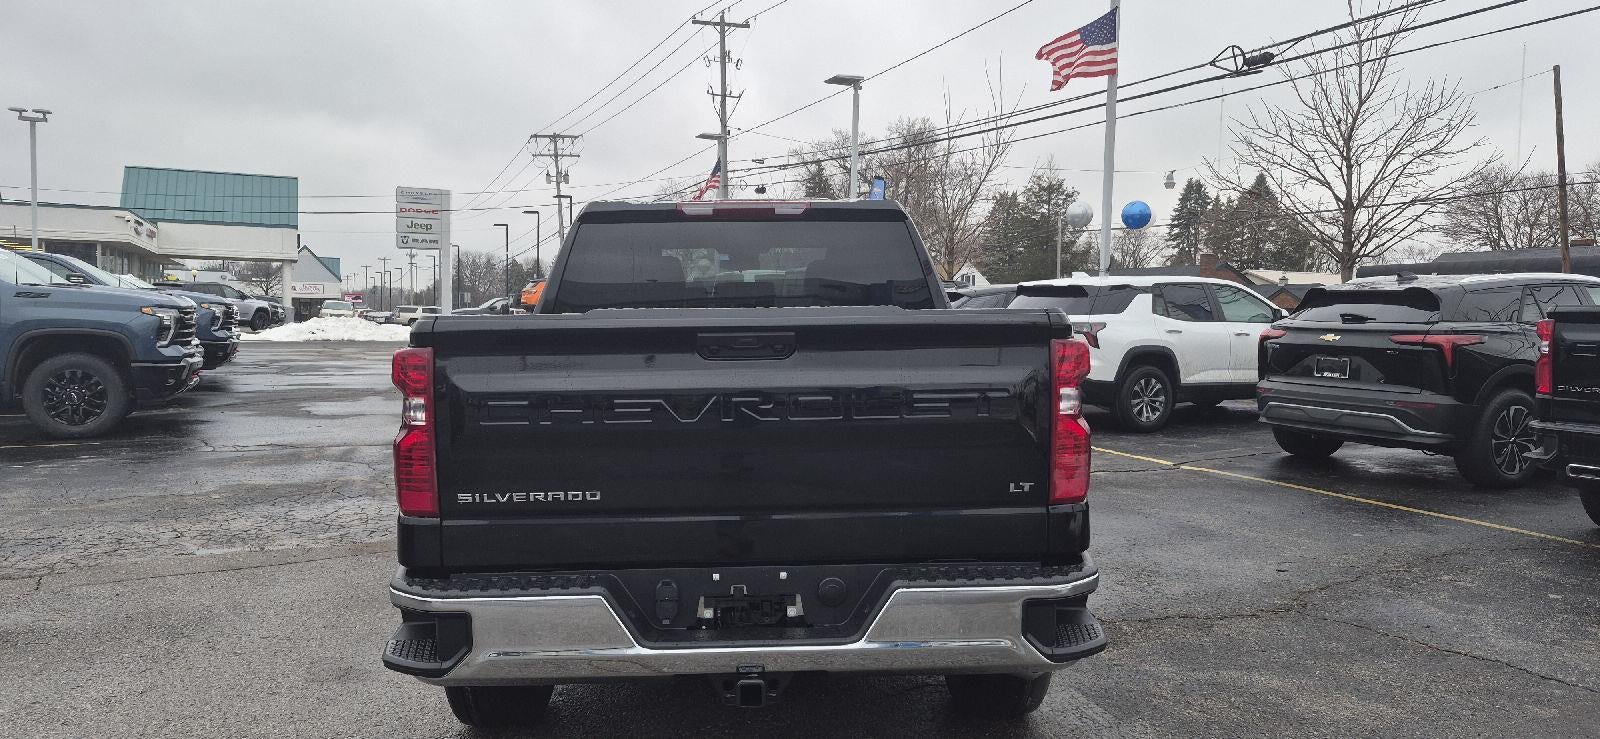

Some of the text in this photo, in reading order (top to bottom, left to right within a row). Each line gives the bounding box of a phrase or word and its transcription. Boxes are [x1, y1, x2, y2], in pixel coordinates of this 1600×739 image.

[406, 220, 433, 231] Jeep
[478, 391, 1009, 425] CHEVROLET
[1009, 482, 1035, 492] LT
[457, 490, 602, 503] SILVERADO
